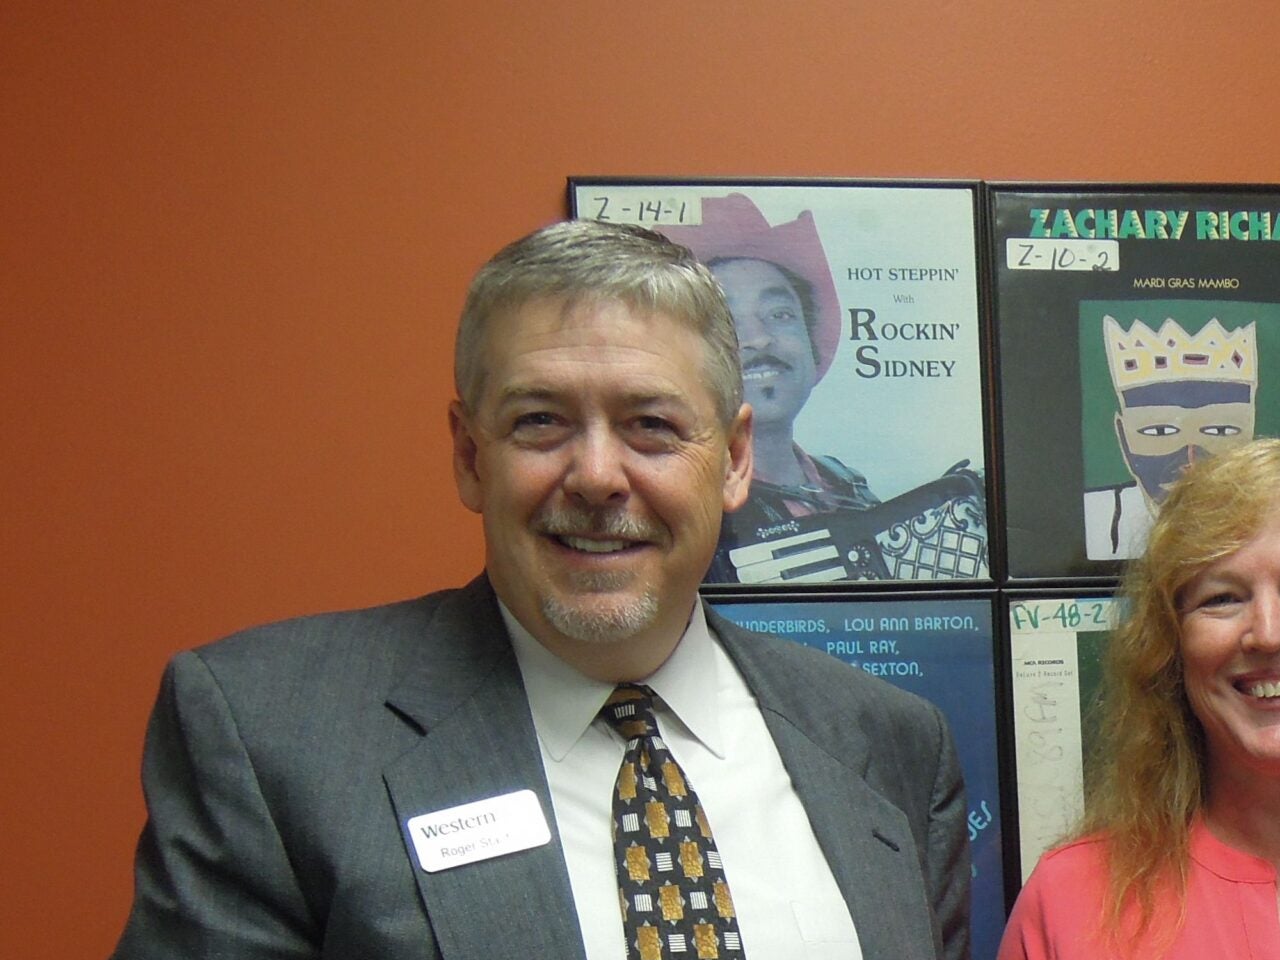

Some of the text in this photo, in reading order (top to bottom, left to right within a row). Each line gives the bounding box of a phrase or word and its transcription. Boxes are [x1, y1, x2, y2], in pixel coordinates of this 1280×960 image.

[1029, 208, 1189, 240] ZACHARY
[847, 267, 960, 281] HOT STEPPIN'
[1133, 278, 1240, 289] MARDI GRAS MAMBO
[892, 294, 916, 304] With
[844, 617, 875, 633] LOU
[914, 616, 980, 633] BARTON,
[826, 640, 900, 656] PAUL RAY,
[862, 661, 924, 678] SEXTON,
[420, 811, 497, 840] Western
